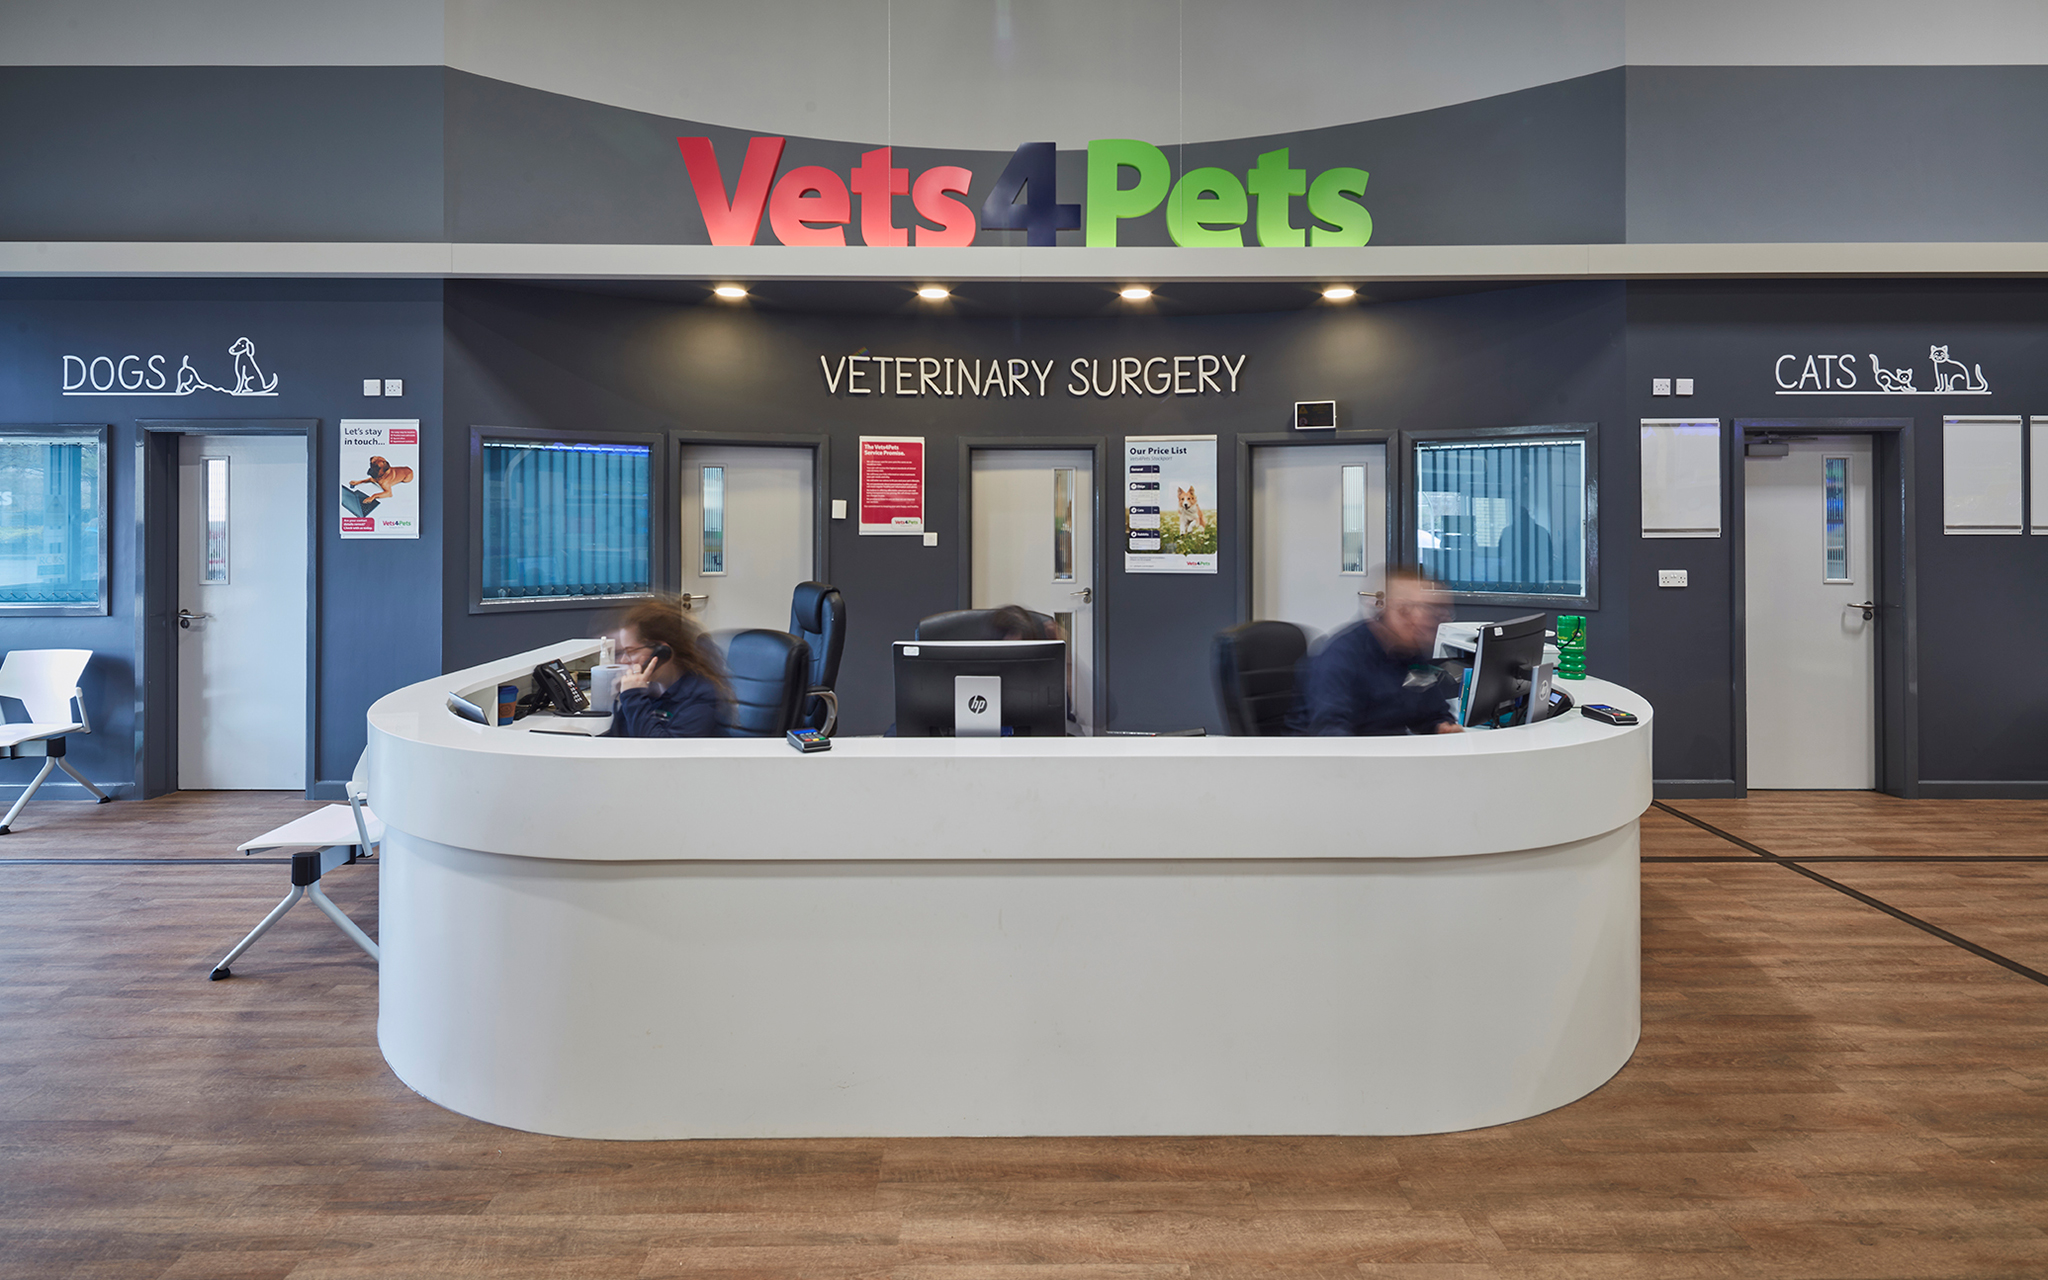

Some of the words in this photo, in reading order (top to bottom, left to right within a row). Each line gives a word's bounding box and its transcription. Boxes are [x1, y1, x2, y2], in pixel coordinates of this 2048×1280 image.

[677, 136, 1373, 248] Vets4Pets
[63, 354, 166, 391] DOGS
[820, 355, 1054, 398] VETERINARY
[1067, 354, 1247, 397] SURGERY
[1774, 353, 1857, 390] CATS
[365, 428, 382, 437] stay
[1148, 447, 1169, 455] Price
